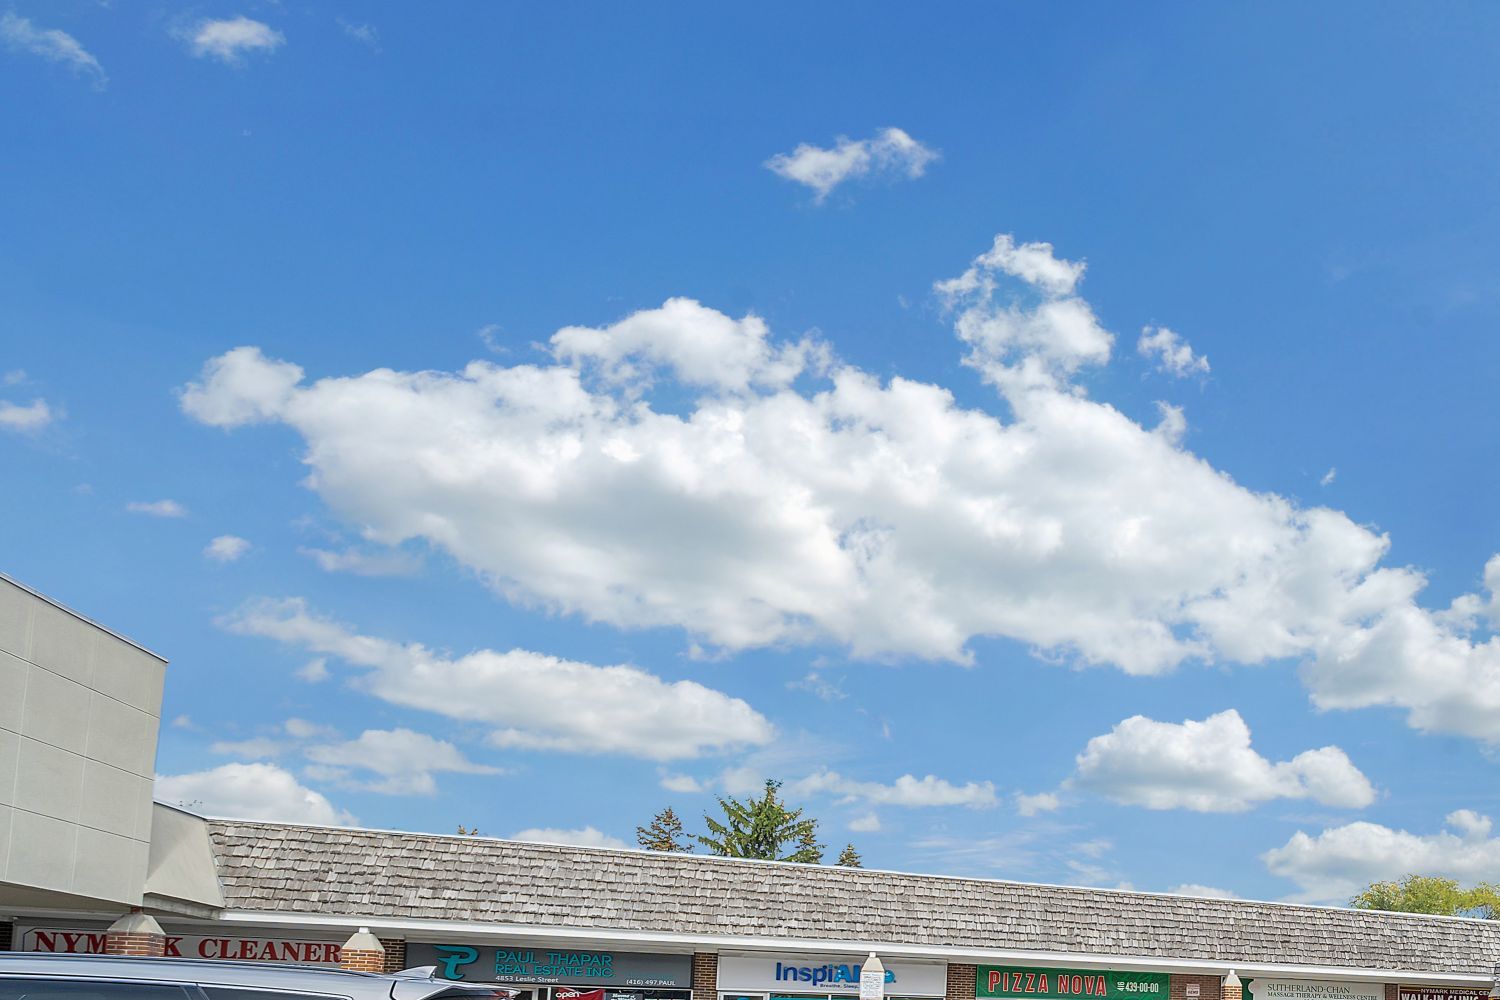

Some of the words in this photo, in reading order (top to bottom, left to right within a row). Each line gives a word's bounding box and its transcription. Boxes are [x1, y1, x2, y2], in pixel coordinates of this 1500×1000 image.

[33, 931, 182, 957] NYMK
[496, 950, 540, 964] PAUL
[545, 952, 613, 966] THAPAR
[495, 964, 529, 975] REAL
[534, 965, 582, 977] ESTATE
[988, 970, 1049, 993] PIZZA
[1057, 974, 1107, 997] NOVA
[1125, 981, 1159, 993] 439-00-00
[1267, 983, 1351, 994] SUTHERLAND-CHAN
[555, 991, 580, 999] open
